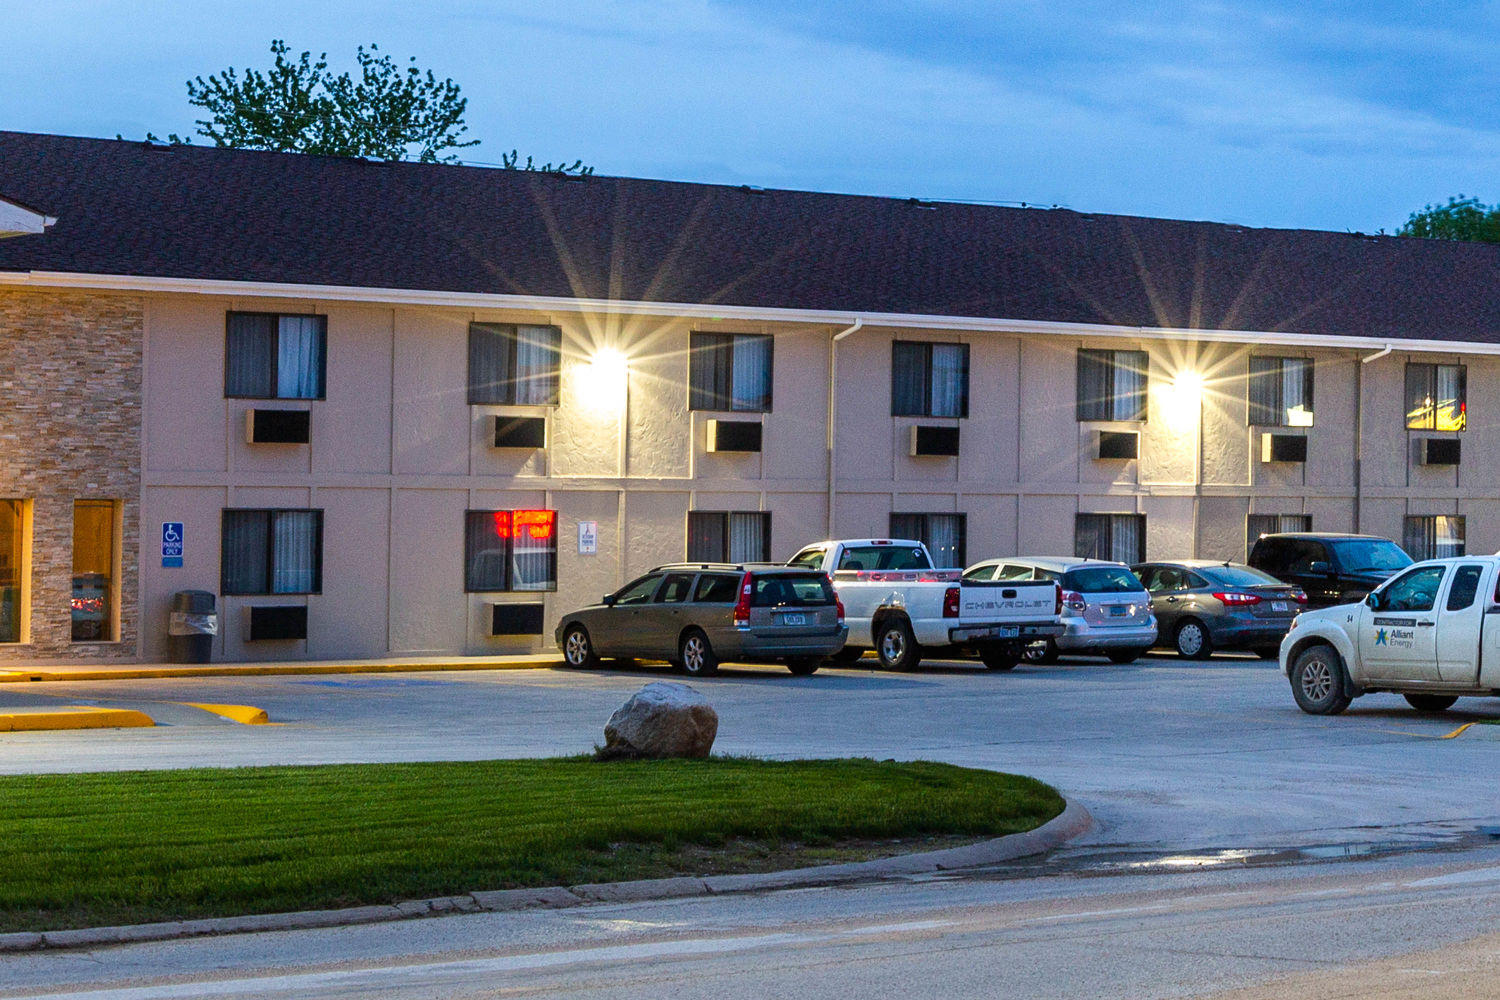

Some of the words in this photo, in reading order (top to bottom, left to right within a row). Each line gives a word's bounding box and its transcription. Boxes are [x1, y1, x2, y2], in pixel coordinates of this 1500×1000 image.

[965, 600, 1051, 609] CHEVROLET
[1390, 629, 1414, 639] Alliant
[1390, 639, 1413, 648] Energy
